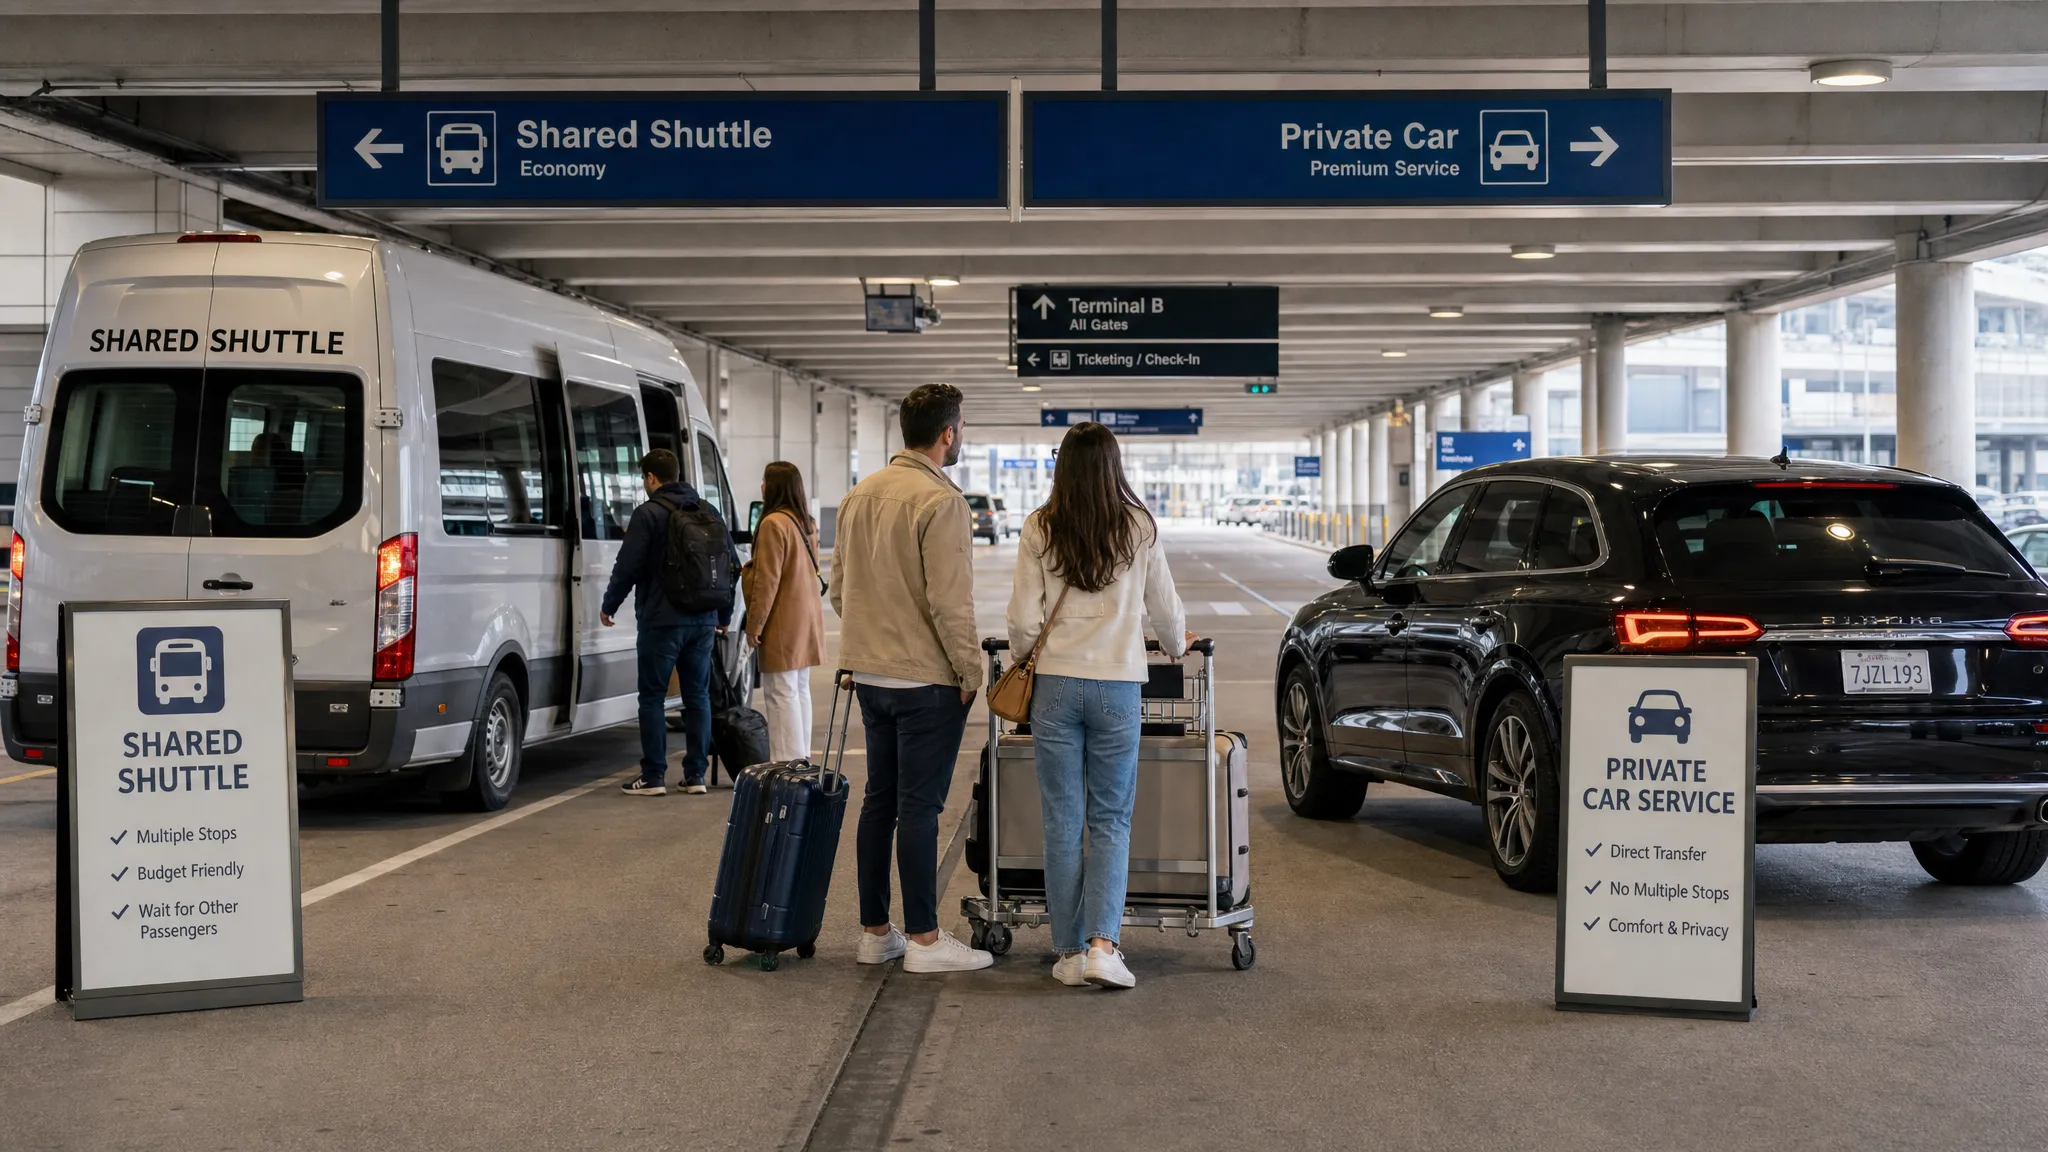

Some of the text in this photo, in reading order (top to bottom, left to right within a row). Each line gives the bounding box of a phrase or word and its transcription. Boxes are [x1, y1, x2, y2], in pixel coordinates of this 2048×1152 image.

[516, 119, 772, 149] Shared Shuttle
[1281, 121, 1459, 150] Private Car
[520, 159, 607, 181] Economy
[1310, 159, 1460, 177] Premium Service
[1068, 297, 1164, 314] Terminal B
[1069, 318, 1129, 331] All Gates
[89, 328, 345, 355] SHARED SHUTTLE
[1076, 353, 1201, 368] Ticketing / Check-In
[1850, 664, 1923, 685] 7JZL193
[123, 729, 243, 759] SHARED
[118, 763, 249, 794] SHUTTLE
[1606, 757, 1707, 783] PRIVATE
[1582, 787, 1735, 815] CAR SERVICE
[137, 826, 237, 846] Multiple Stops
[1610, 843, 1707, 862] Direct Transfer
[137, 860, 245, 884] Budget Friendly
[1610, 881, 1730, 904] No Multiple Stops
[138, 899, 239, 919] Wait for Other
[140, 924, 218, 941] Passengers
[1608, 917, 1729, 942] Comfort & Privacy
